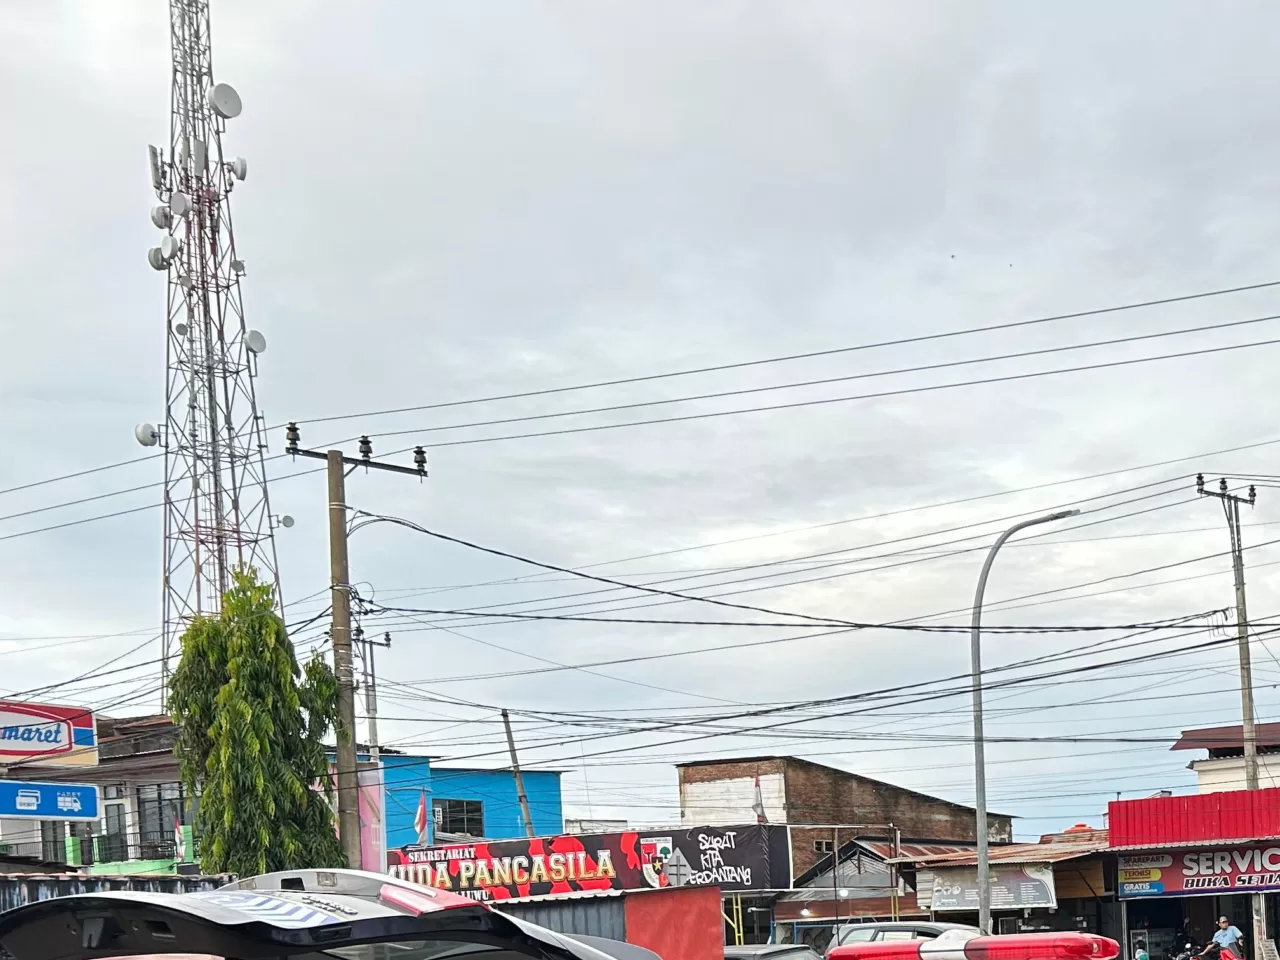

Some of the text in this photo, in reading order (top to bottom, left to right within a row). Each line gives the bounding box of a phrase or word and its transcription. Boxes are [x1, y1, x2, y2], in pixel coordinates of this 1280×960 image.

[408, 847, 477, 863] SEKRETARIAT
[700, 850, 724, 870] KITA
[1123, 856, 1165, 864] SPAREPART
[459, 849, 617, 888] PANCASILA
[1124, 882, 1150, 890] GRATIS
[1183, 875, 1231, 890] BUKA
